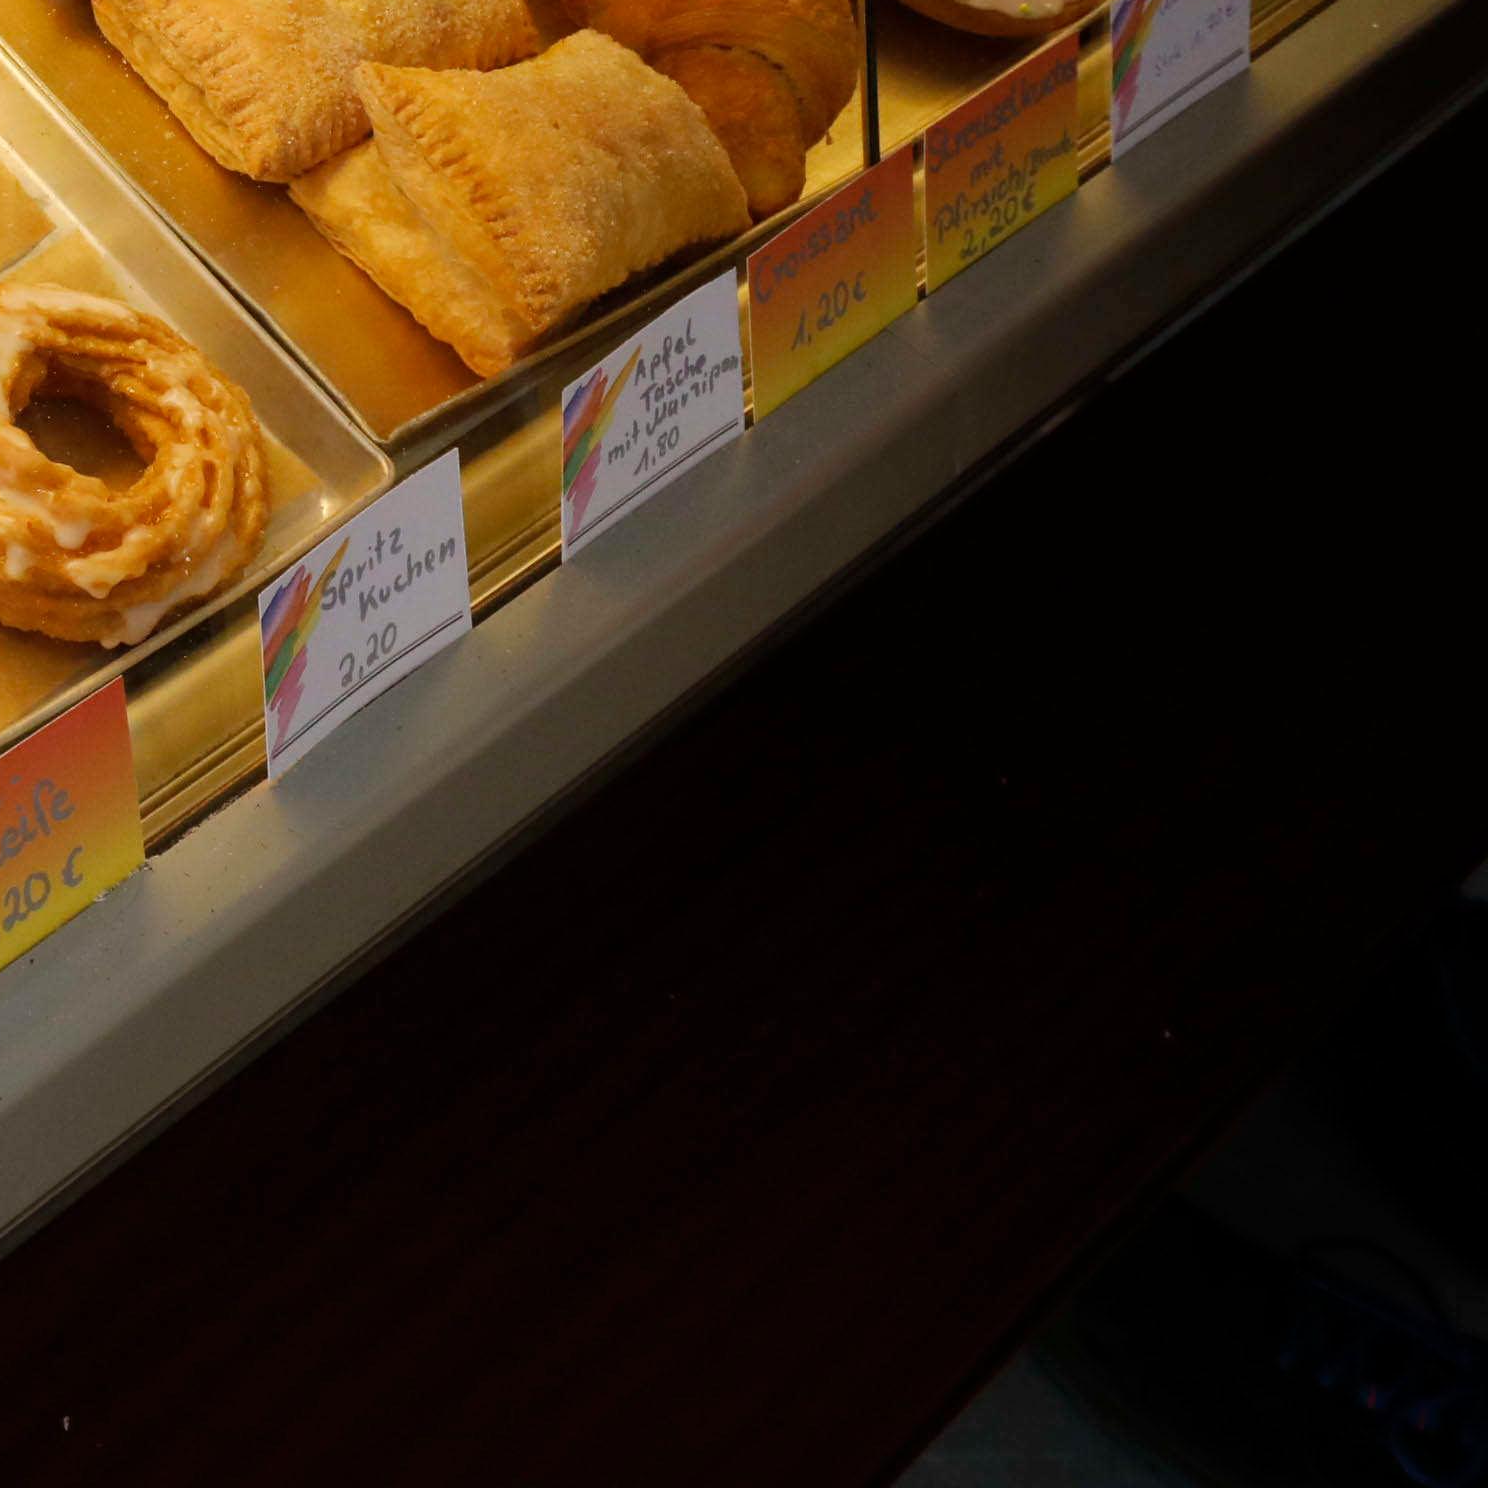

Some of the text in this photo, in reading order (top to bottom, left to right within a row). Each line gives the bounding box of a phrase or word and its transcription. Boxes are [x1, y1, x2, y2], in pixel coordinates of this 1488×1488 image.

[970, 139, 1005, 189] mit
[754, 187, 880, 304] Croissant
[634, 317, 698, 386] Apfel
[640, 353, 707, 412] Tasche
[606, 355, 741, 465] mit Marzipan
[321, 526, 404, 611] Spritz
[359, 537, 457, 622] Kuchen
[339, 621, 398, 688] 2,20
